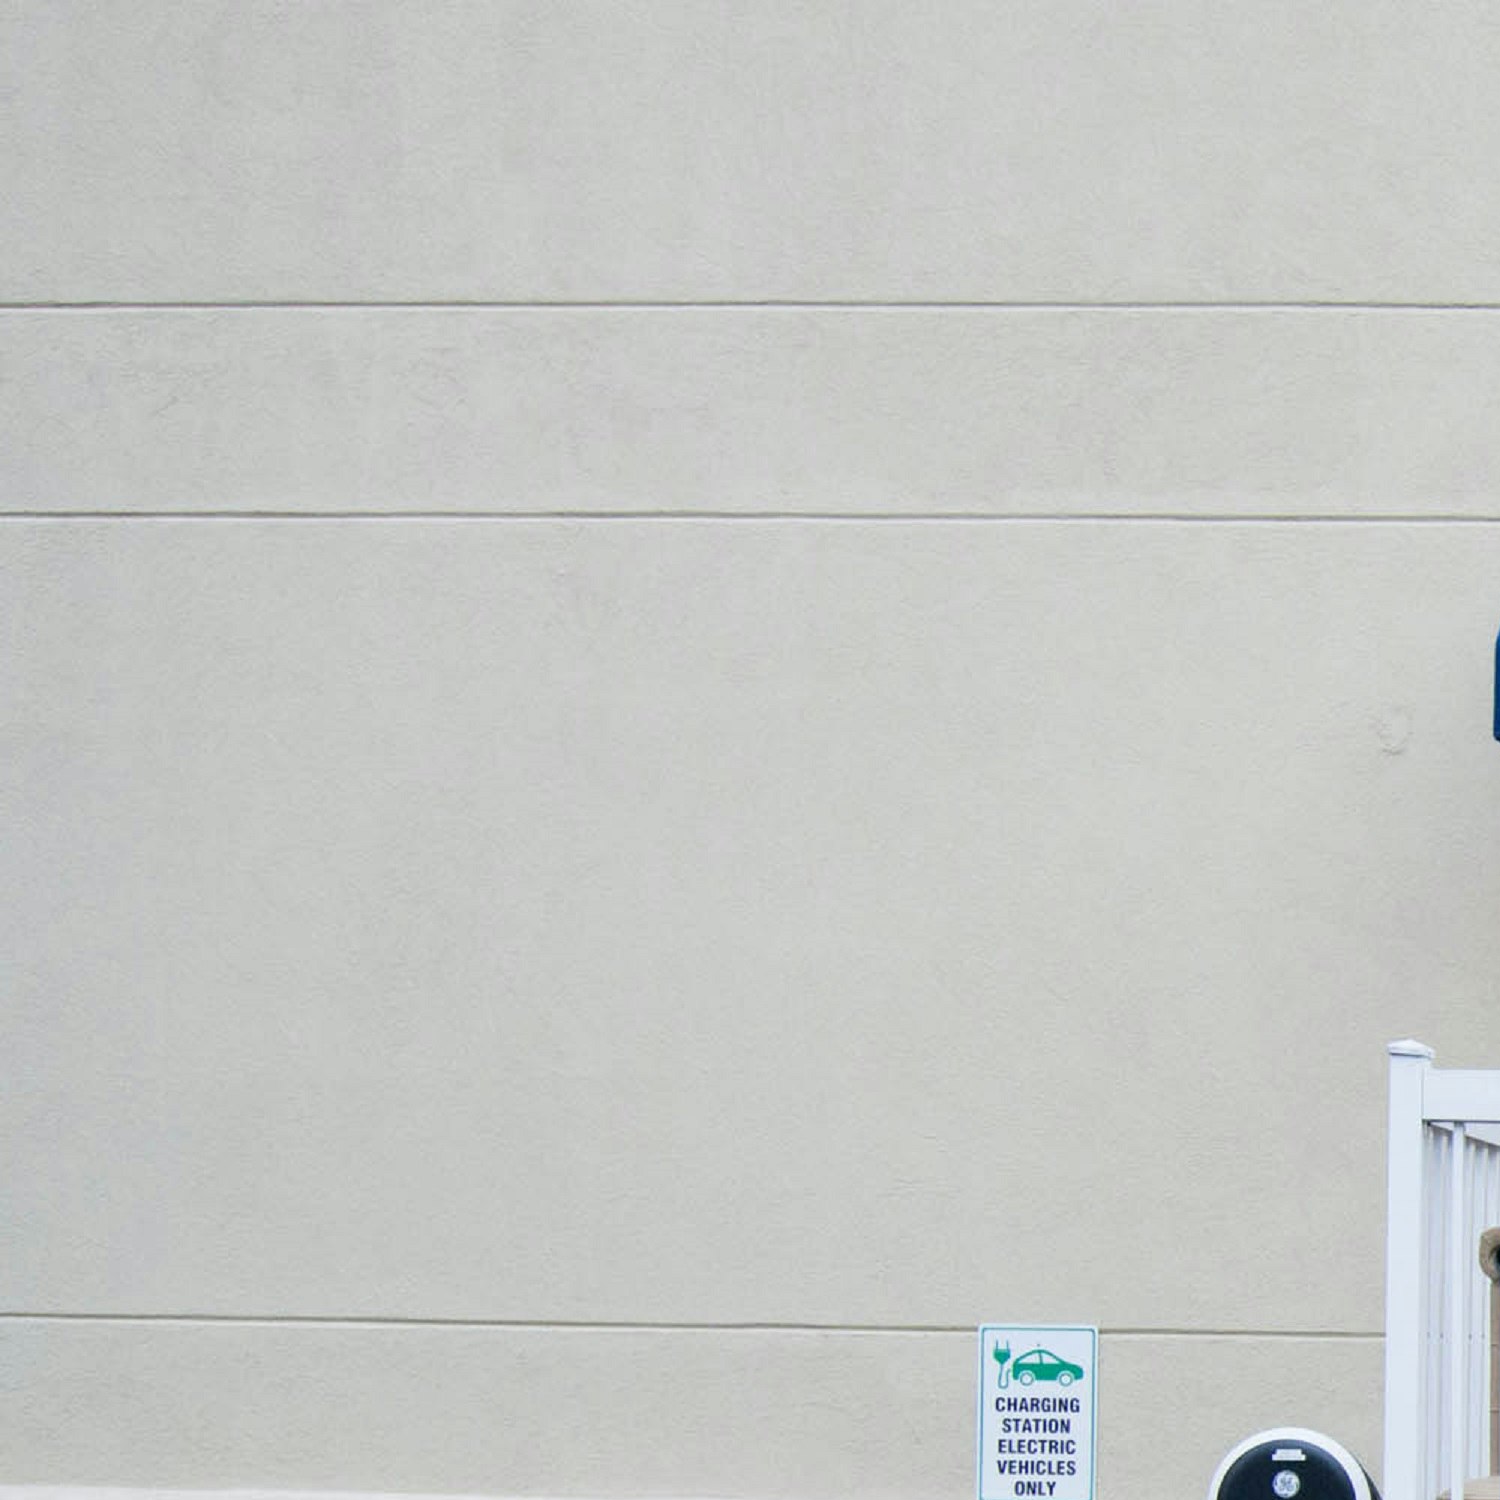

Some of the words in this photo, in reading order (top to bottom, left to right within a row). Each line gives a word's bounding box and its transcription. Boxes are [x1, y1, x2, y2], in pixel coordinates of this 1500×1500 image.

[995, 1396, 1080, 1413] CHARGING
[1001, 1417, 1071, 1434] STATION
[997, 1438, 1076, 1455] ELECTRIC
[996, 1459, 1077, 1476] VEHICLES
[1014, 1480, 1057, 1497] ONLY
